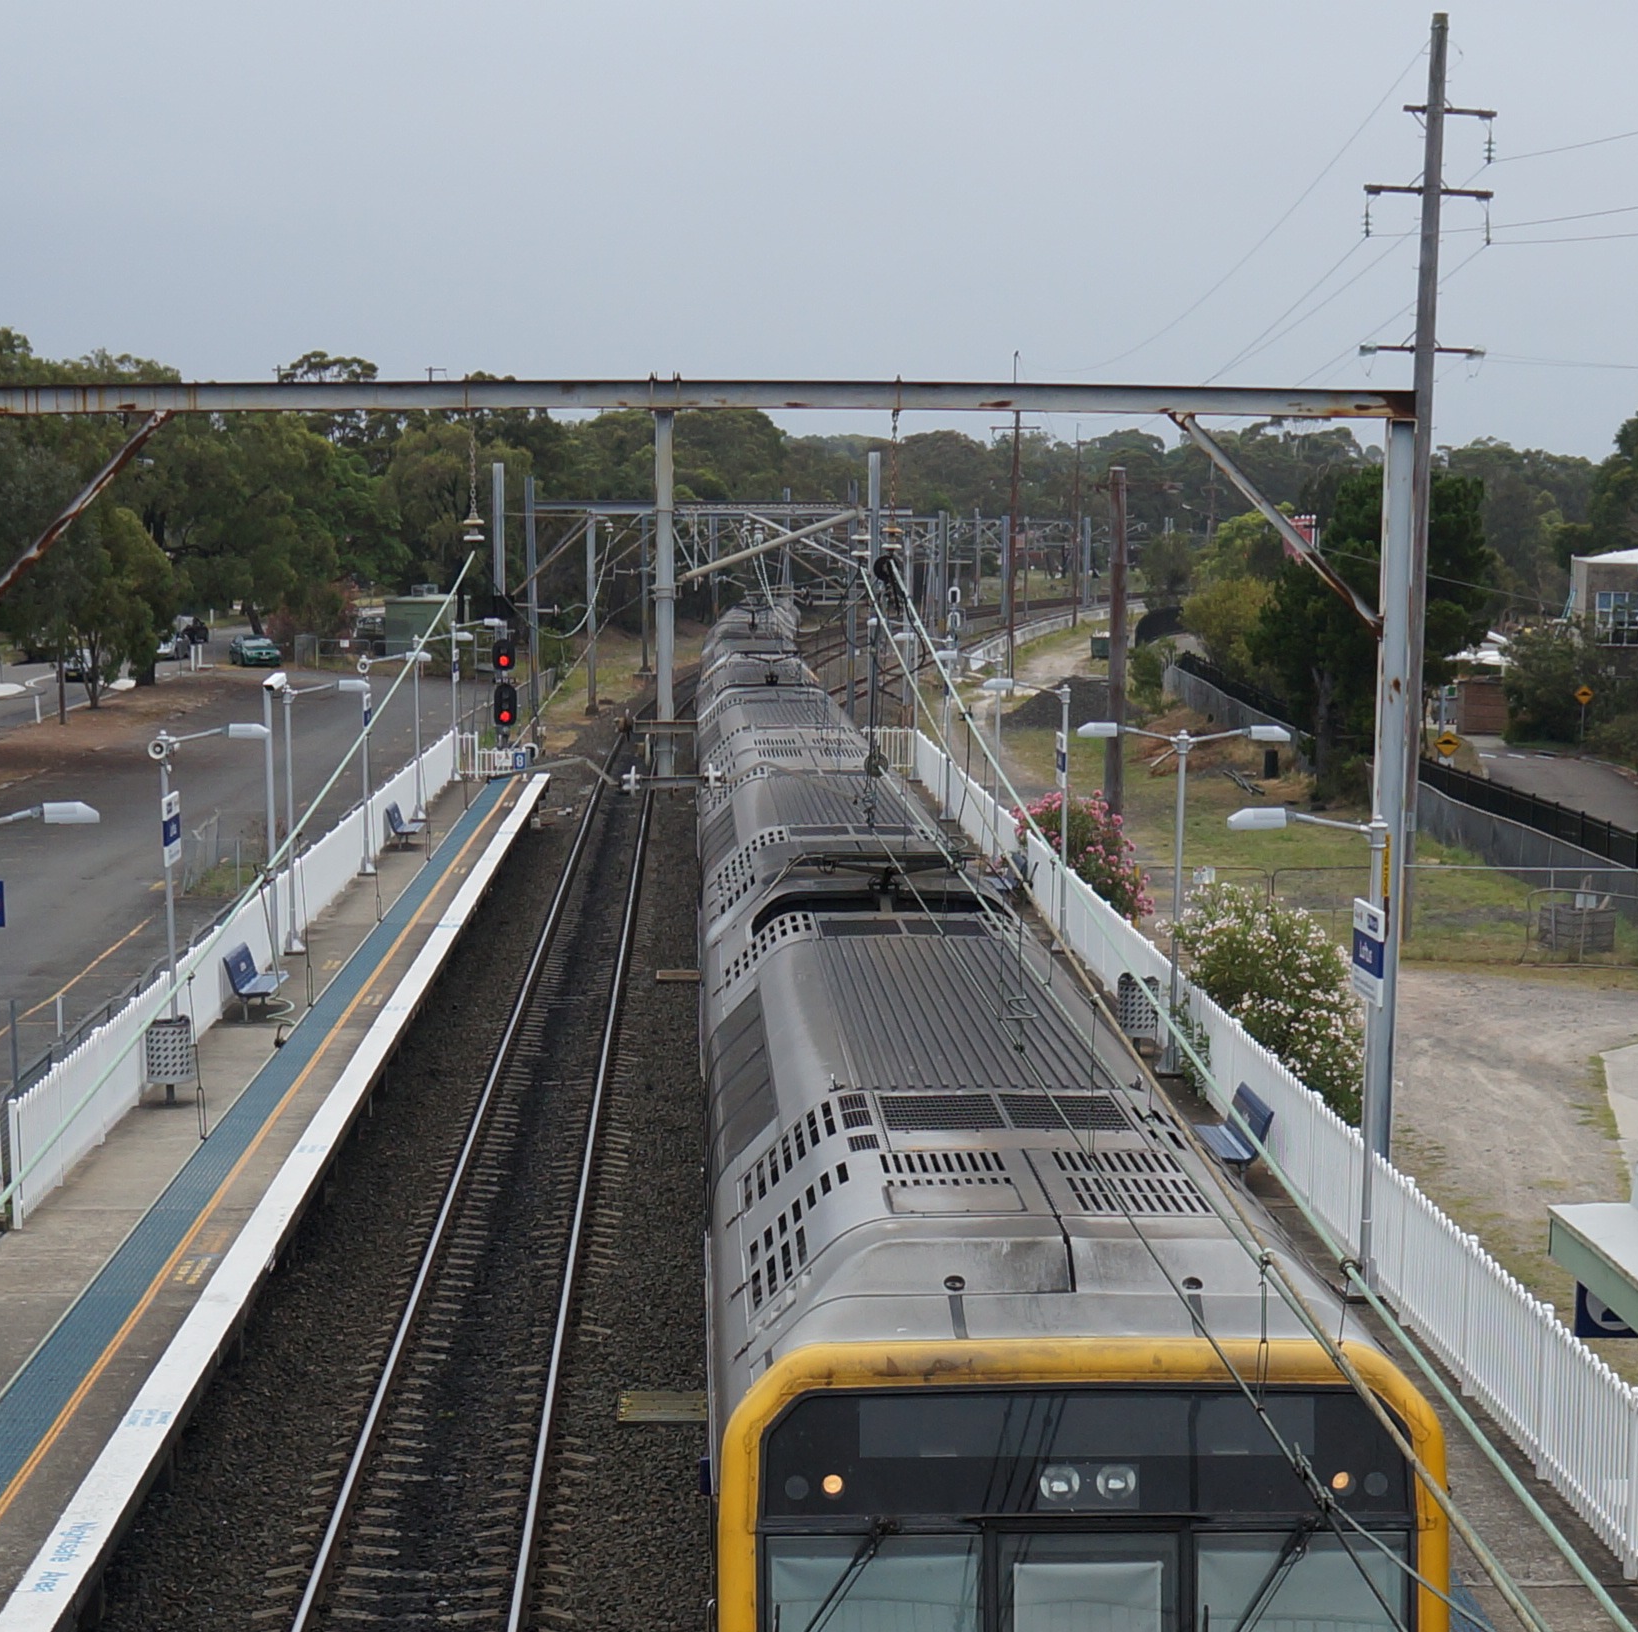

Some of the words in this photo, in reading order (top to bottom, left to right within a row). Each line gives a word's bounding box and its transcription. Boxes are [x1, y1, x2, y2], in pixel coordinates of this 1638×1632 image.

[516, 754, 525, 768] 8
[49, 1522, 99, 1563] Nightsafe
[31, 1571, 70, 1593] Area
